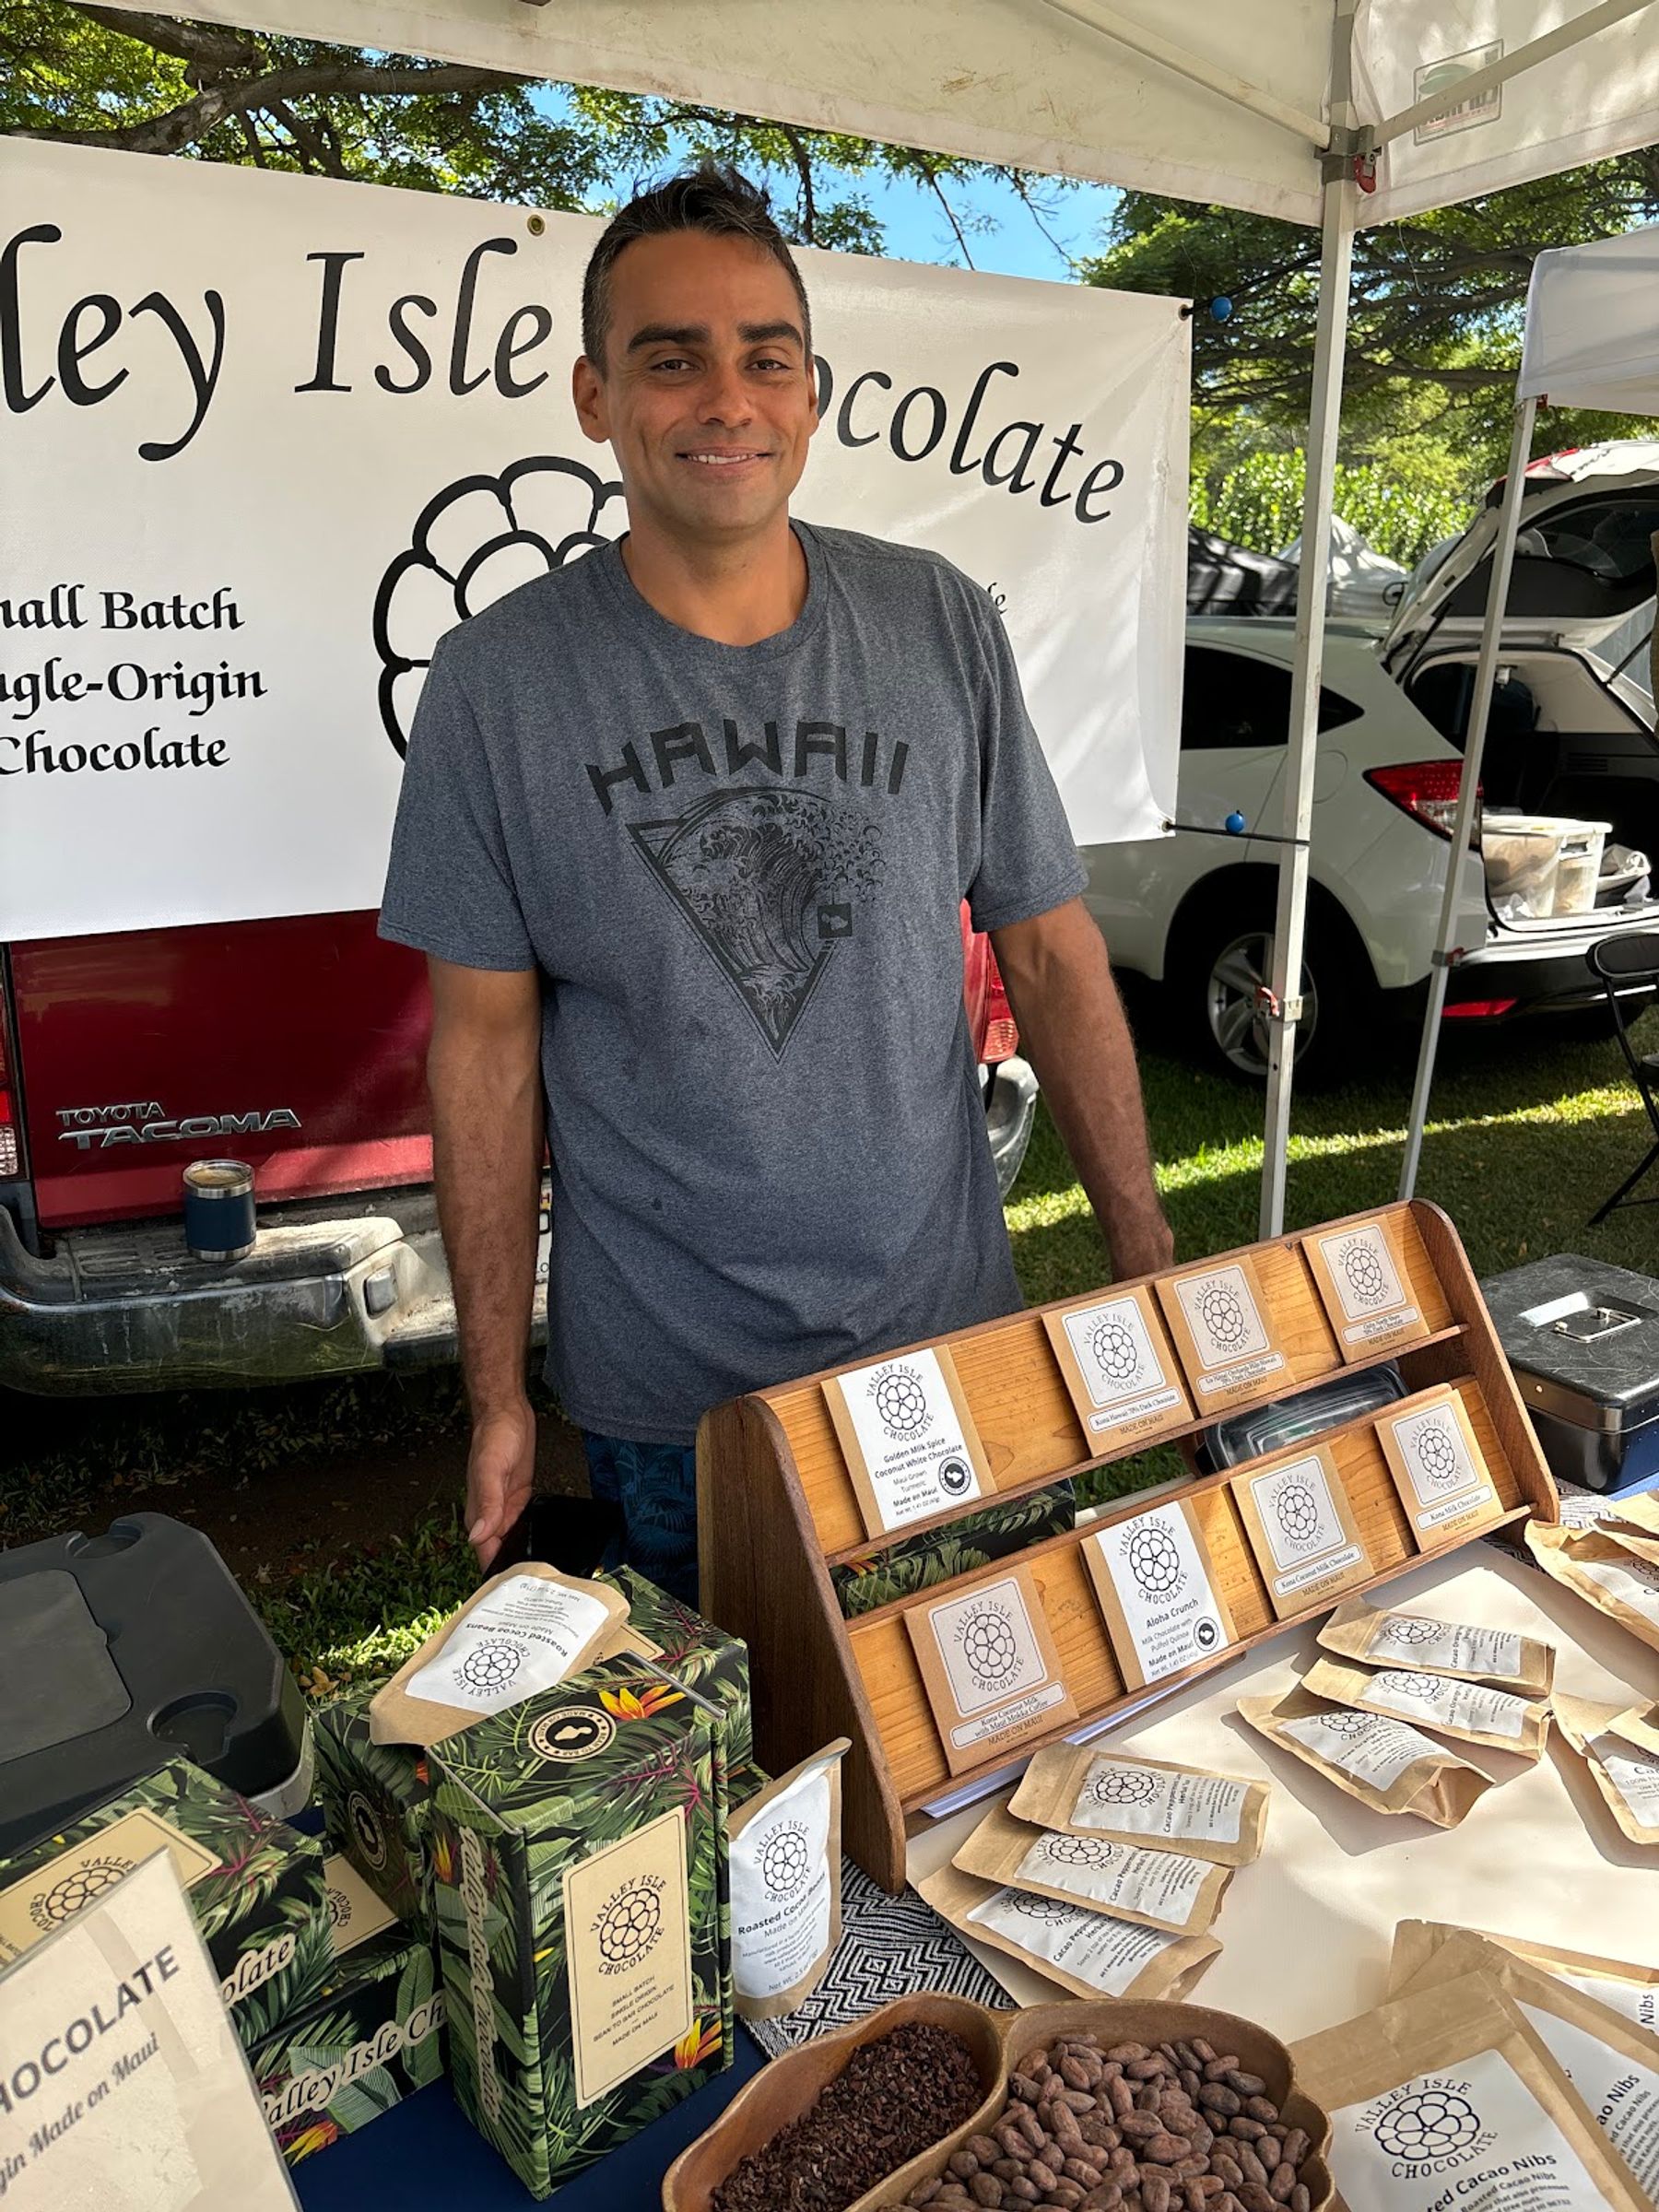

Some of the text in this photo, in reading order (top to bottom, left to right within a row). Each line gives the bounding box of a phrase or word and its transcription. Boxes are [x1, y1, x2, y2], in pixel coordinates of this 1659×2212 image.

[295, 237, 553, 398] Isle
[99, 587, 245, 629] Batch
[0, 726, 230, 775] Chocolate
[584, 719, 909, 817] HAWAII
[56, 1102, 165, 1126] TOYOTA
[58, 1109, 301, 1149] TACOMA
[1194, 1279, 1240, 1311] VALLEY ISLE
[1084, 1312, 1135, 1344] VALLEY ISLE
[1210, 1328, 1252, 1353] CHOCOLATE
[866, 1364, 924, 1396] VALLEY ISLE
[883, 1413, 934, 1441] CHOCOLATE
[875, 1444, 962, 1478] Coconut White Chocolate
[883, 1450, 910, 1463] Golden
[926, 1438, 946, 1449] Spice
[1269, 1475, 1316, 1509] VALLEY ISLE
[1119, 1516, 1175, 1557] VALLEY ISLE
[1284, 1524, 1325, 1552] CHOCOLATE
[1137, 1570, 1189, 1606] CHOCOLATE
[465, 1623, 496, 1632] Beans
[954, 1601, 1014, 1643] VALLEY ISLE
[1147, 1598, 1199, 1629] Aloha Crunch
[477, 1637, 530, 1657] CHOCOLATE
[528, 1633, 569, 1657] Roasted
[453, 1667, 516, 1697] VALLEY ISLE
[971, 1657, 1024, 1692] CHOCOLATE
[981, 1715, 997, 1726] Kona
[988, 1730, 1012, 1745] MADE
[1024, 1714, 1043, 1728] MAUI
[1163, 1810, 1172, 1832] Cacao
[754, 1820, 809, 1864] VALLEY ISLE
[764, 1865, 813, 1902] CHOCOLATE
[1110, 1878, 1123, 1900] Cacao
[591, 1875, 666, 1932] VALLEY ISLE
[738, 1911, 781, 1936] Roasted
[764, 1923, 786, 1937] Made
[598, 1926, 665, 1975] CHOCOLATE
[1053, 1939, 1073, 1961] Cacao
[610, 1985, 657, 2019] SINGLE ORIGIN
[612, 1976, 655, 2007] SMALL BATCH
[593, 2028, 611, 2042] BEAN
[622, 2010, 636, 2023] BAR
[637, 1984, 675, 2014] CHOCOLATE
[1639, 1994, 1654, 2025] Nibs
[612, 2030, 631, 2046] MADE
[642, 2012, 659, 2026] MAUI
[264, 1994, 447, 2124] alley Isle Ch
[29, 2101, 84, 2159] Made
[88, 2081, 110, 2108] on
[112, 2031, 159, 2086] Maui
[1606, 2075, 1641, 2102] Nibs
[1355, 2078, 1472, 2133] VALLEY ISLE
[1392, 2130, 1498, 2179] CHOCOLATE
[1455, 2166, 1510, 2194] Cacao
[1512, 2155, 1557, 2171] Nibs
[1499, 2176, 1530, 2190] Cacao
[1531, 2171, 1557, 2182] Nibs
